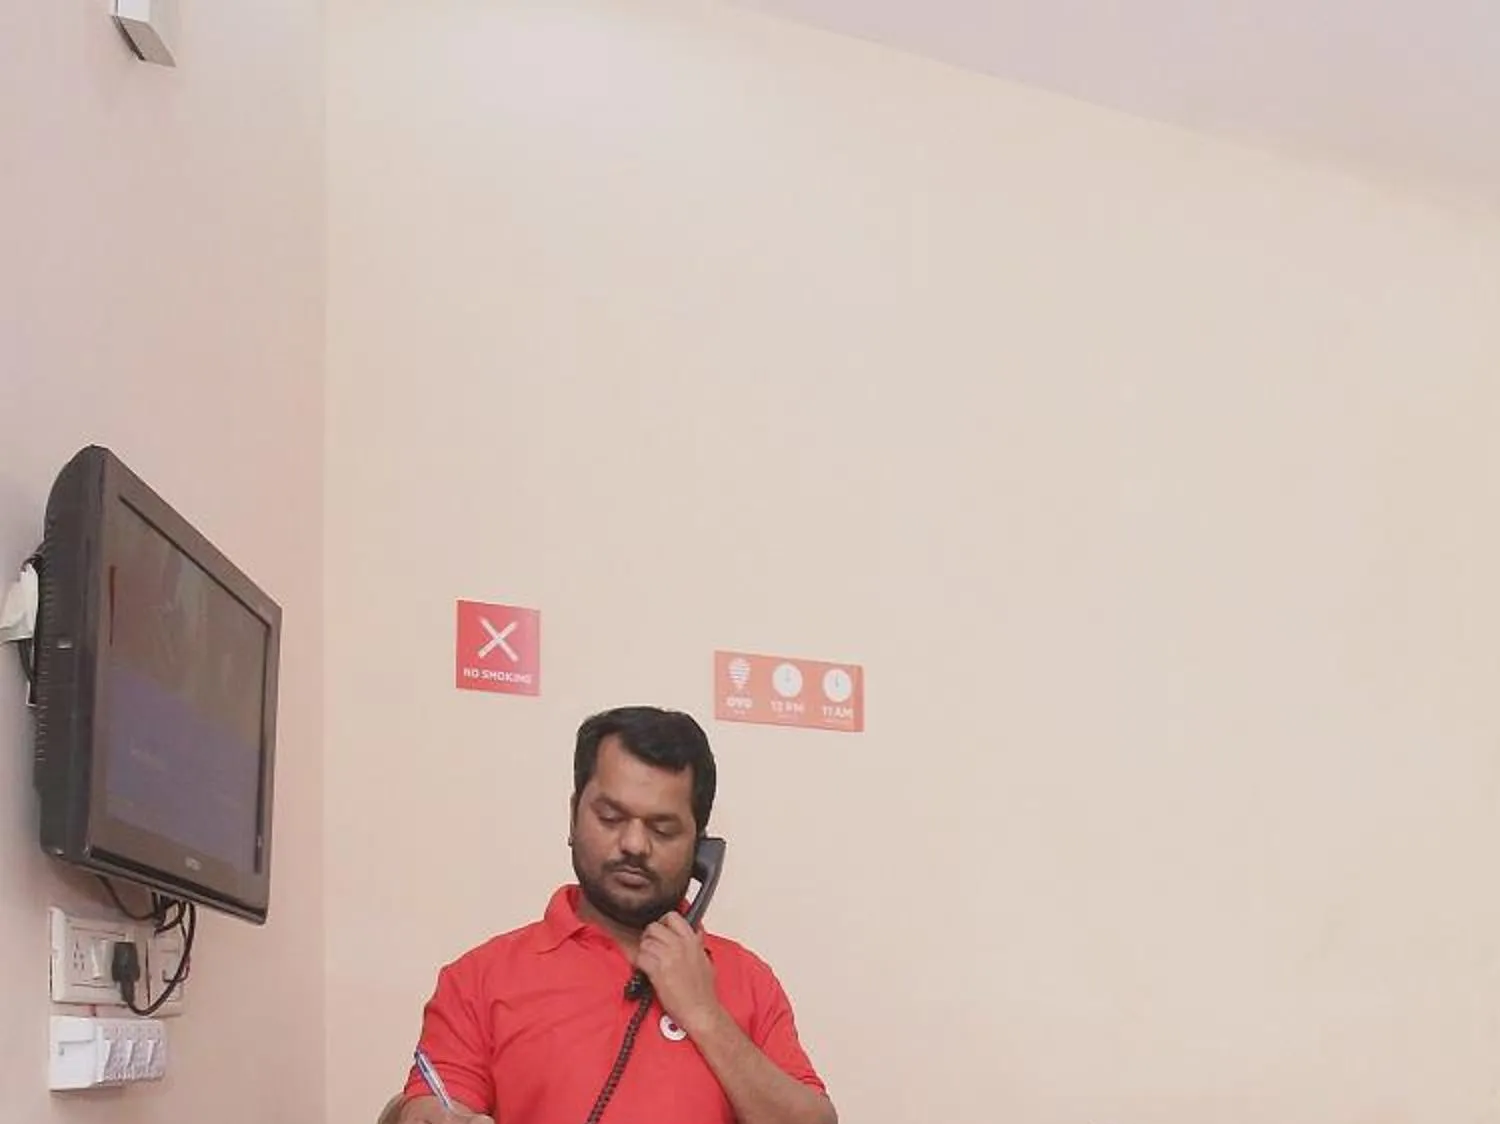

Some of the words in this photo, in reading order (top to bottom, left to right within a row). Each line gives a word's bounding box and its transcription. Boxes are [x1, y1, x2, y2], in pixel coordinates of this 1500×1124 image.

[463, 667, 479, 679] NO
[481, 668, 532, 685] SMOKING
[833, 707, 854, 719] AM
